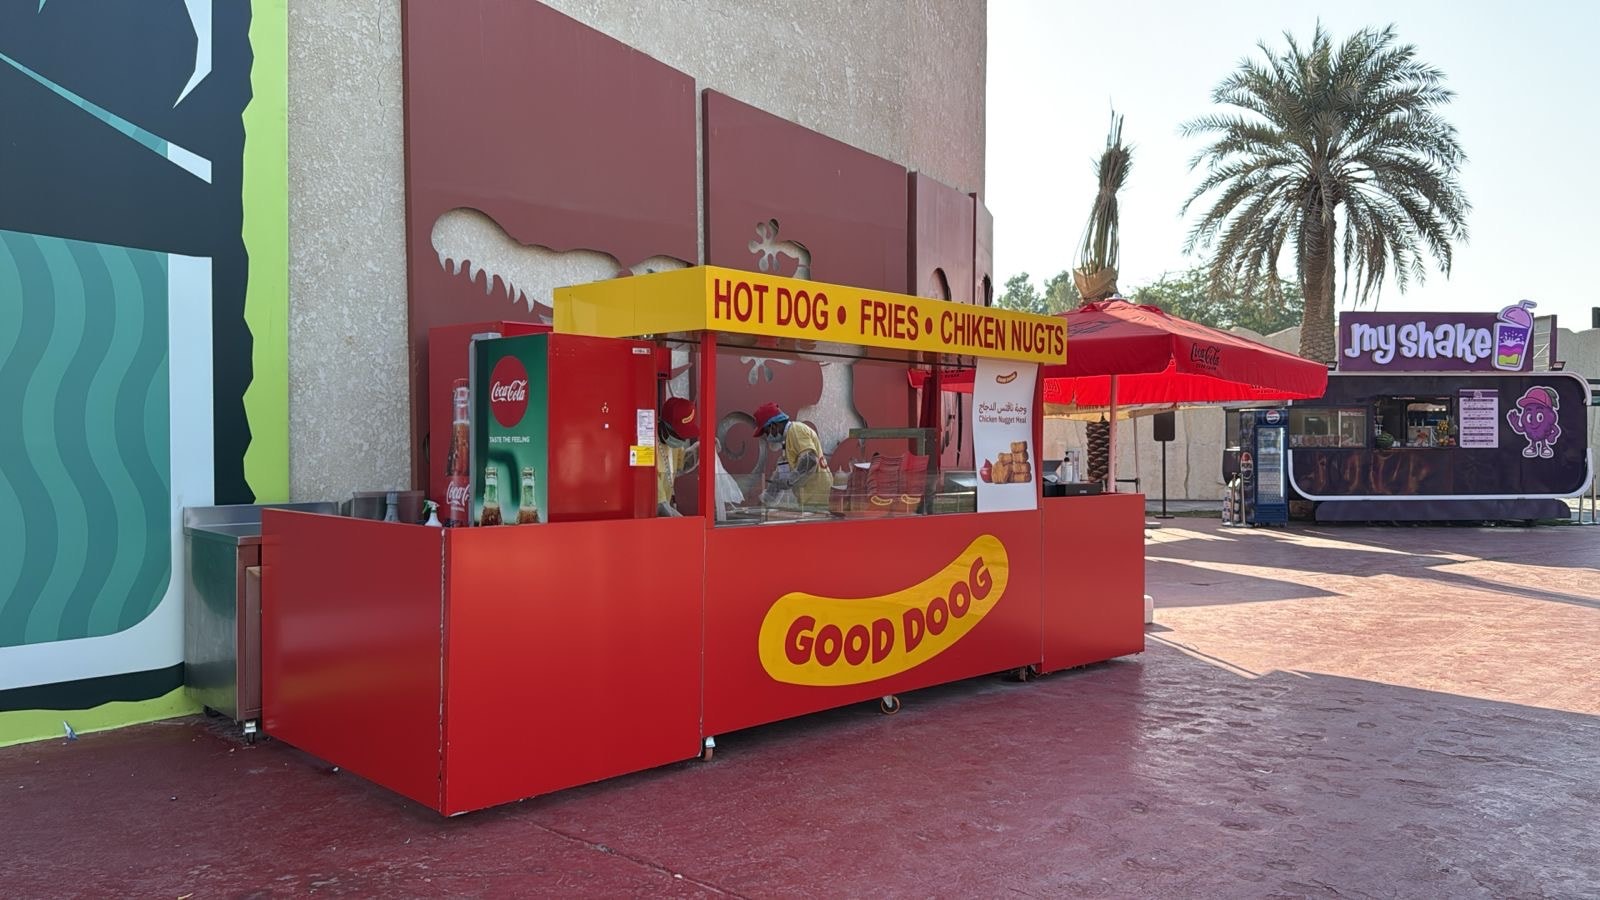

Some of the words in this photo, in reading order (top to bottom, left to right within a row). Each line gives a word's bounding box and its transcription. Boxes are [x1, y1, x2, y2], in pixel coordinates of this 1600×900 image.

[714, 278, 768, 324] HOT
[776, 287, 829, 331] DOG
[860, 299, 919, 341] FRIES
[940, 310, 1006, 351] CHIKEN
[1011, 320, 1064, 356] NUGTS
[491, 379, 528, 402] Coca-Cola
[978, 414, 997, 423] Chicken
[998, 415, 1015, 425] Nugget
[1015, 415, 1027, 424] Meal
[785, 615, 895, 667] GOOD
[903, 556, 993, 653] DOOG
